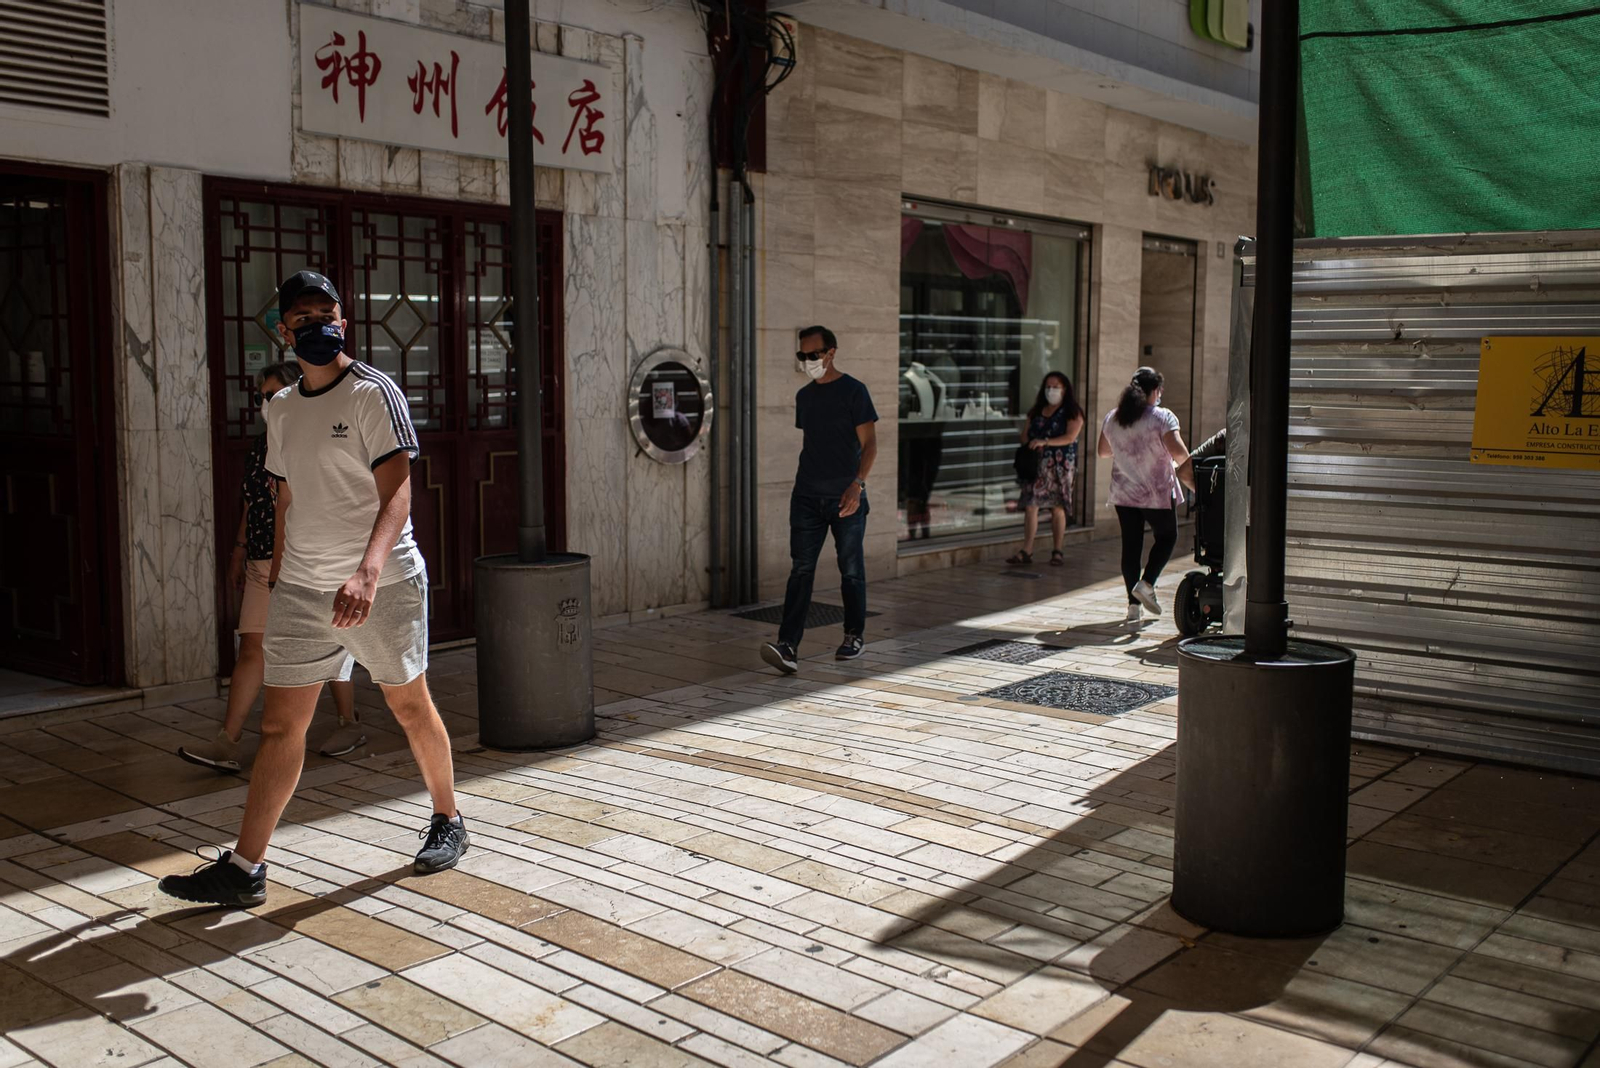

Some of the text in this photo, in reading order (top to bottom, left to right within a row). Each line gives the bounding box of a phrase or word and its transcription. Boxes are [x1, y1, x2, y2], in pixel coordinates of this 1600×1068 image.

[1528, 422, 1600, 437] Alto La E
[1526, 441, 1555, 449] EMPRESA
